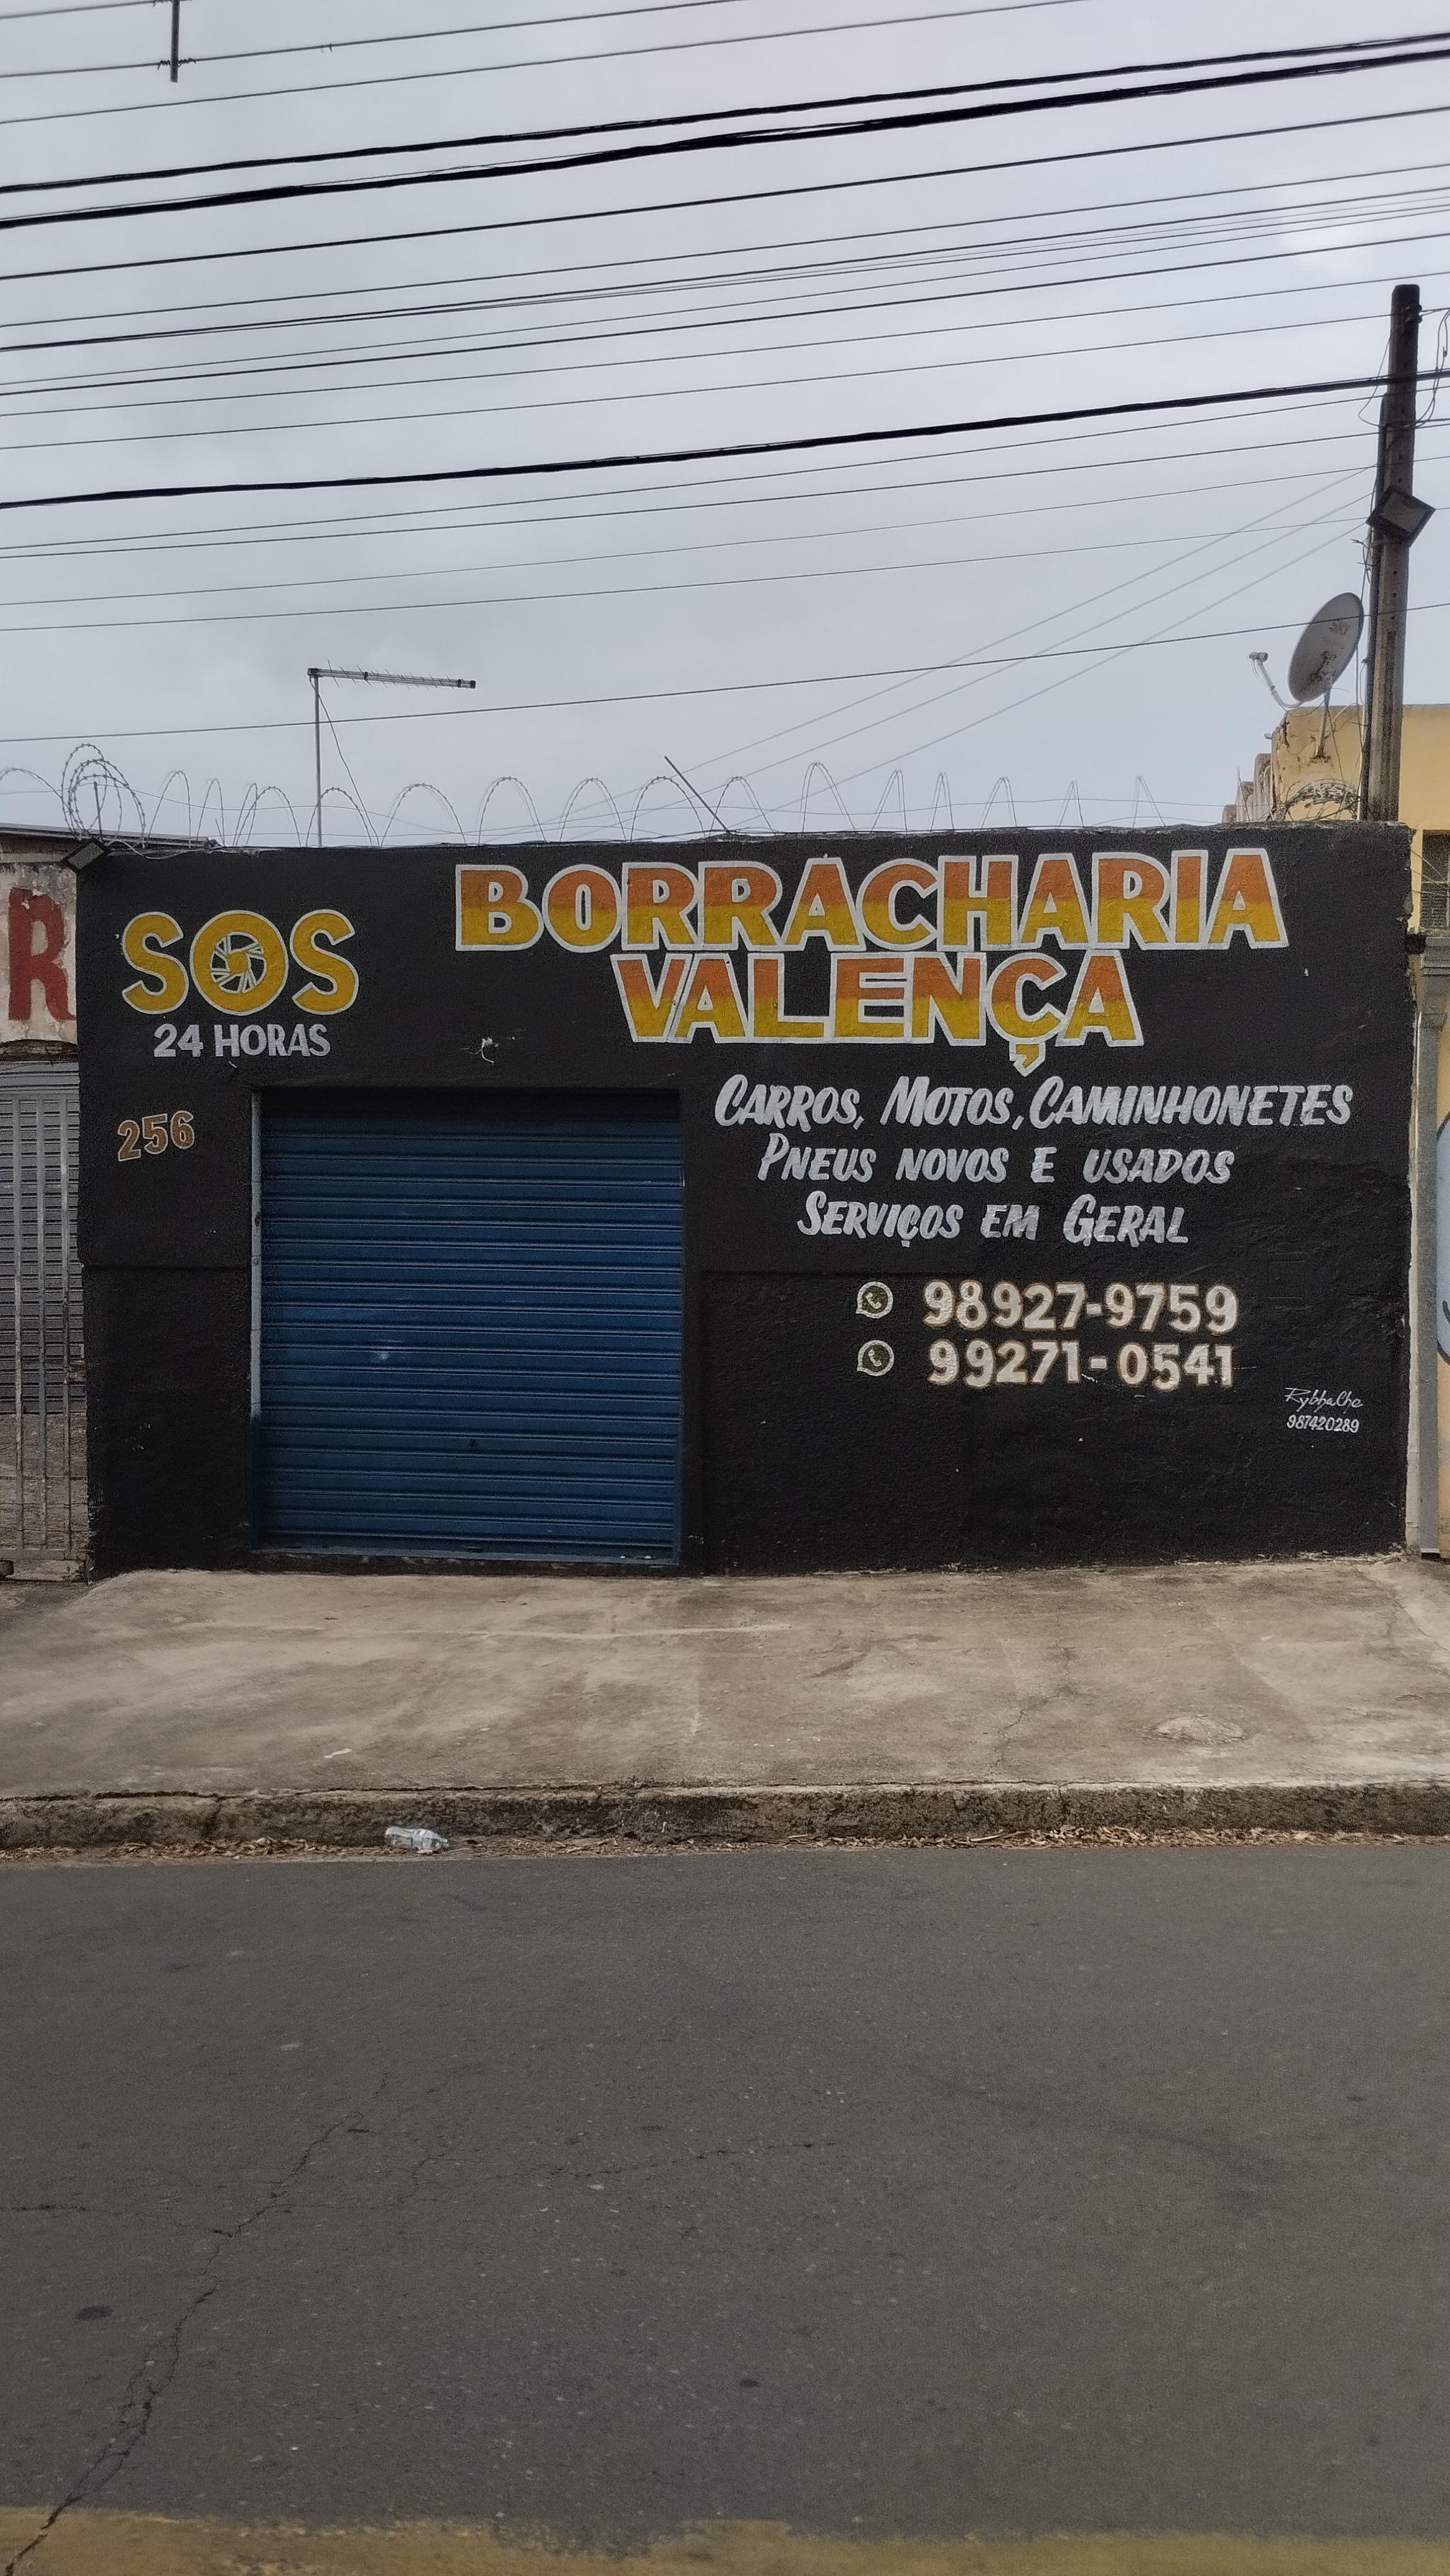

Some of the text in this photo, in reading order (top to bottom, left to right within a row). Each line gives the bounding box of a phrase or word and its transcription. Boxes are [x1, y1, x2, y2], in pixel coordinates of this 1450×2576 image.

[455, 848, 1289, 953] BORRACHARIA
[8, 887, 76, 1020] R
[122, 909, 359, 1016] SOS
[153, 1023, 331, 1058] 24 HORAS
[610, 949, 1144, 1076] VALENÇA
[715, 1074, 865, 1132] CARROS,
[1029, 1075, 1353, 1130] CAMINHONETES
[117, 1110, 196, 1162] 256
[758, 1133, 1235, 1184] PNEUS NOVOS E USADOS
[797, 1191, 1188, 1248] SERVIÇOS EM GERAL
[923, 1279, 1239, 1333] 98927-9759
[1286, 1414, 1360, 1433] 987420289
